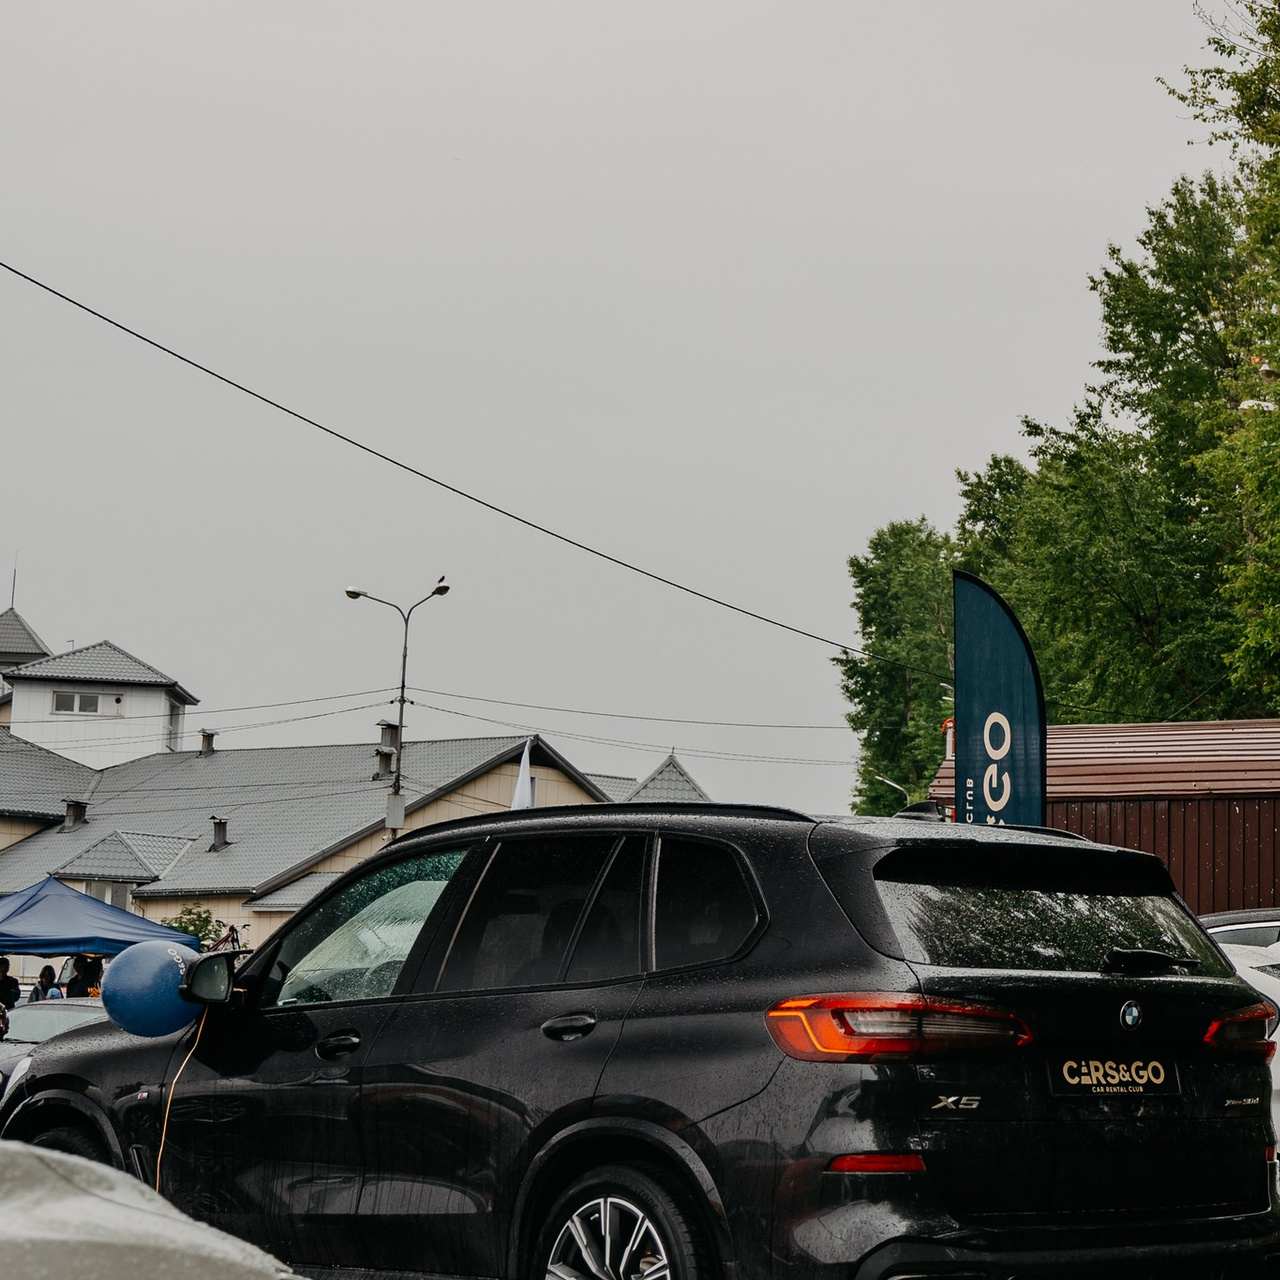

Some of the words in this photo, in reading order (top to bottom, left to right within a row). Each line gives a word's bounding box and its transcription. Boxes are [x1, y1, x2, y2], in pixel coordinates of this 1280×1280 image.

[1062, 1060, 1165, 1085] CARS&GO
[1128, 1085, 1144, 1093] CLUB
[931, 1095, 982, 1110] X5
